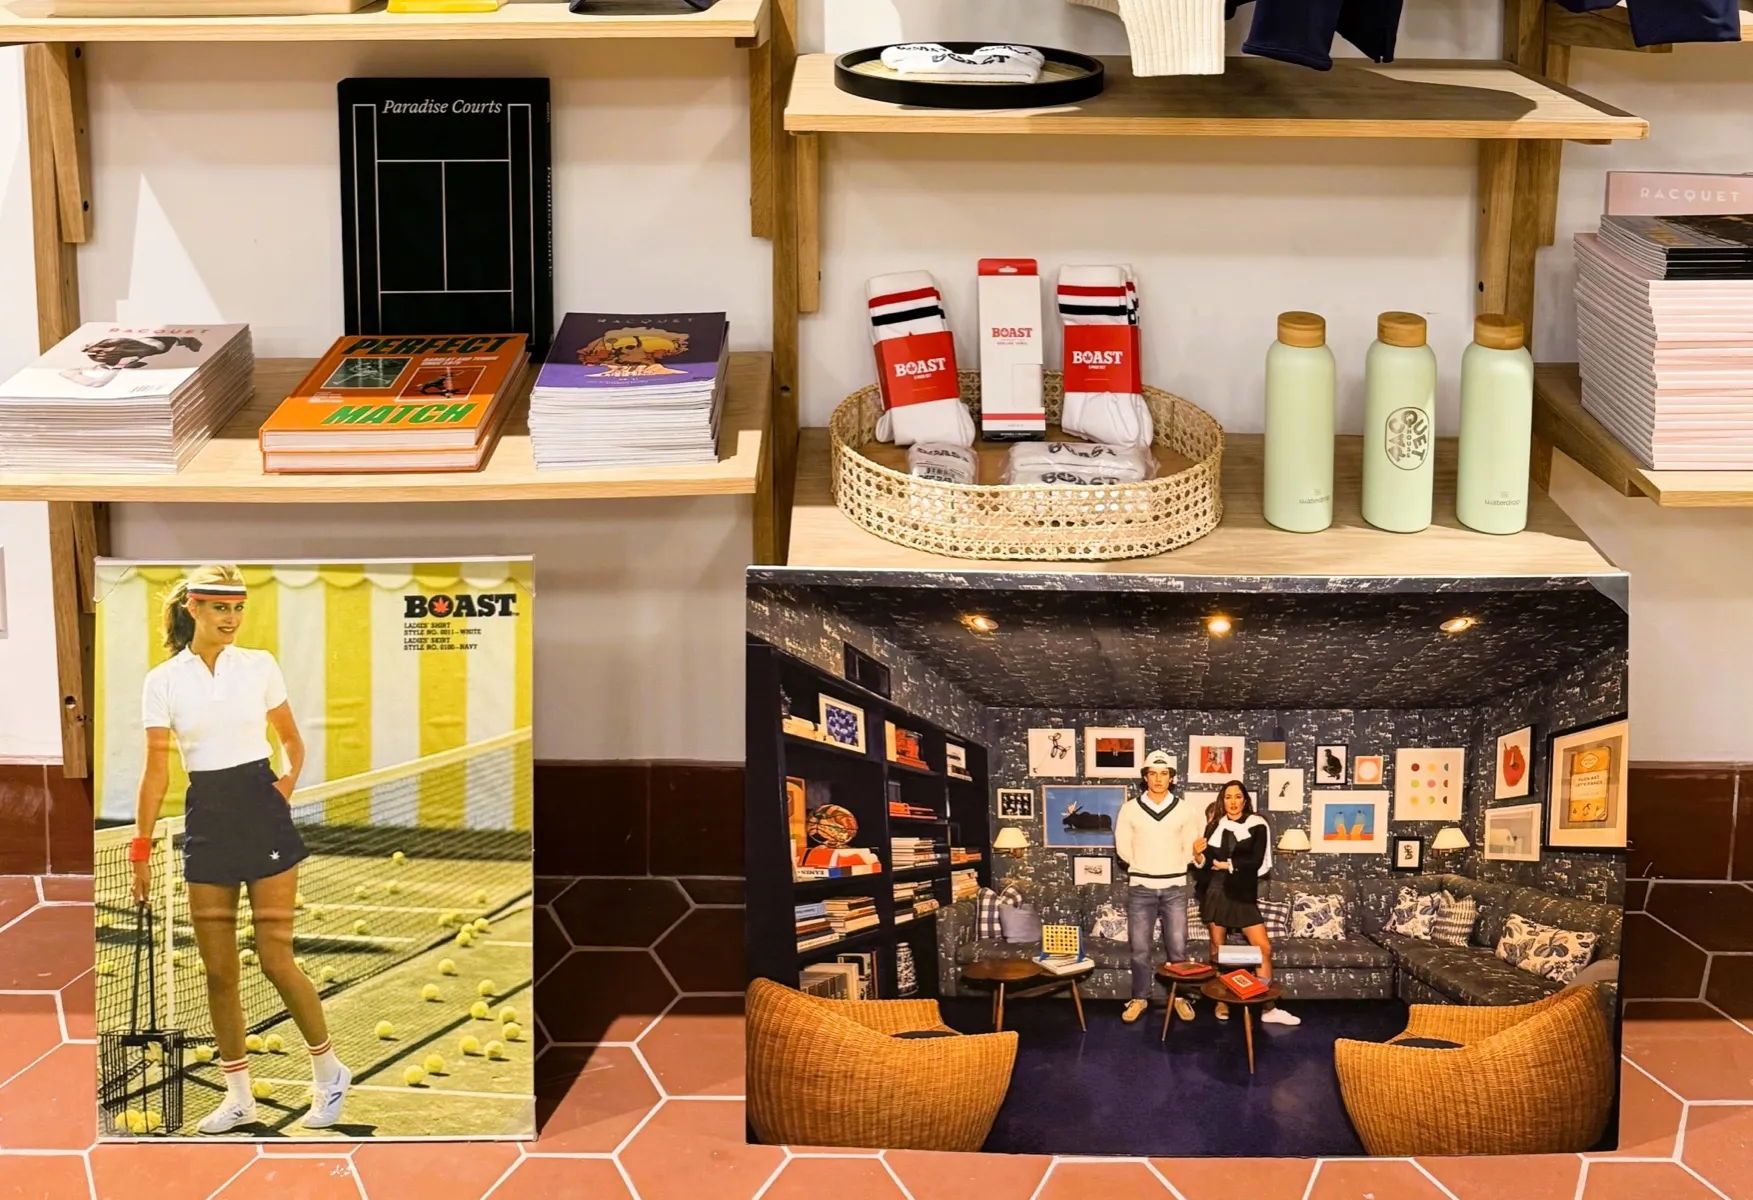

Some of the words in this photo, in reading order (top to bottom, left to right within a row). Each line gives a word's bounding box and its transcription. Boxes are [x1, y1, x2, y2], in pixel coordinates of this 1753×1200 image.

[382, 99, 449, 114] Paradise
[452, 99, 503, 114] Courts
[1640, 187, 1741, 202] RACQUET
[991, 327, 1033, 338] BOAST
[341, 336, 516, 355] PERFECT
[1072, 350, 1123, 365] BOAST
[893, 357, 946, 378] BOAST
[320, 403, 478, 425] MATCH
[404, 593, 517, 618] BOAST
